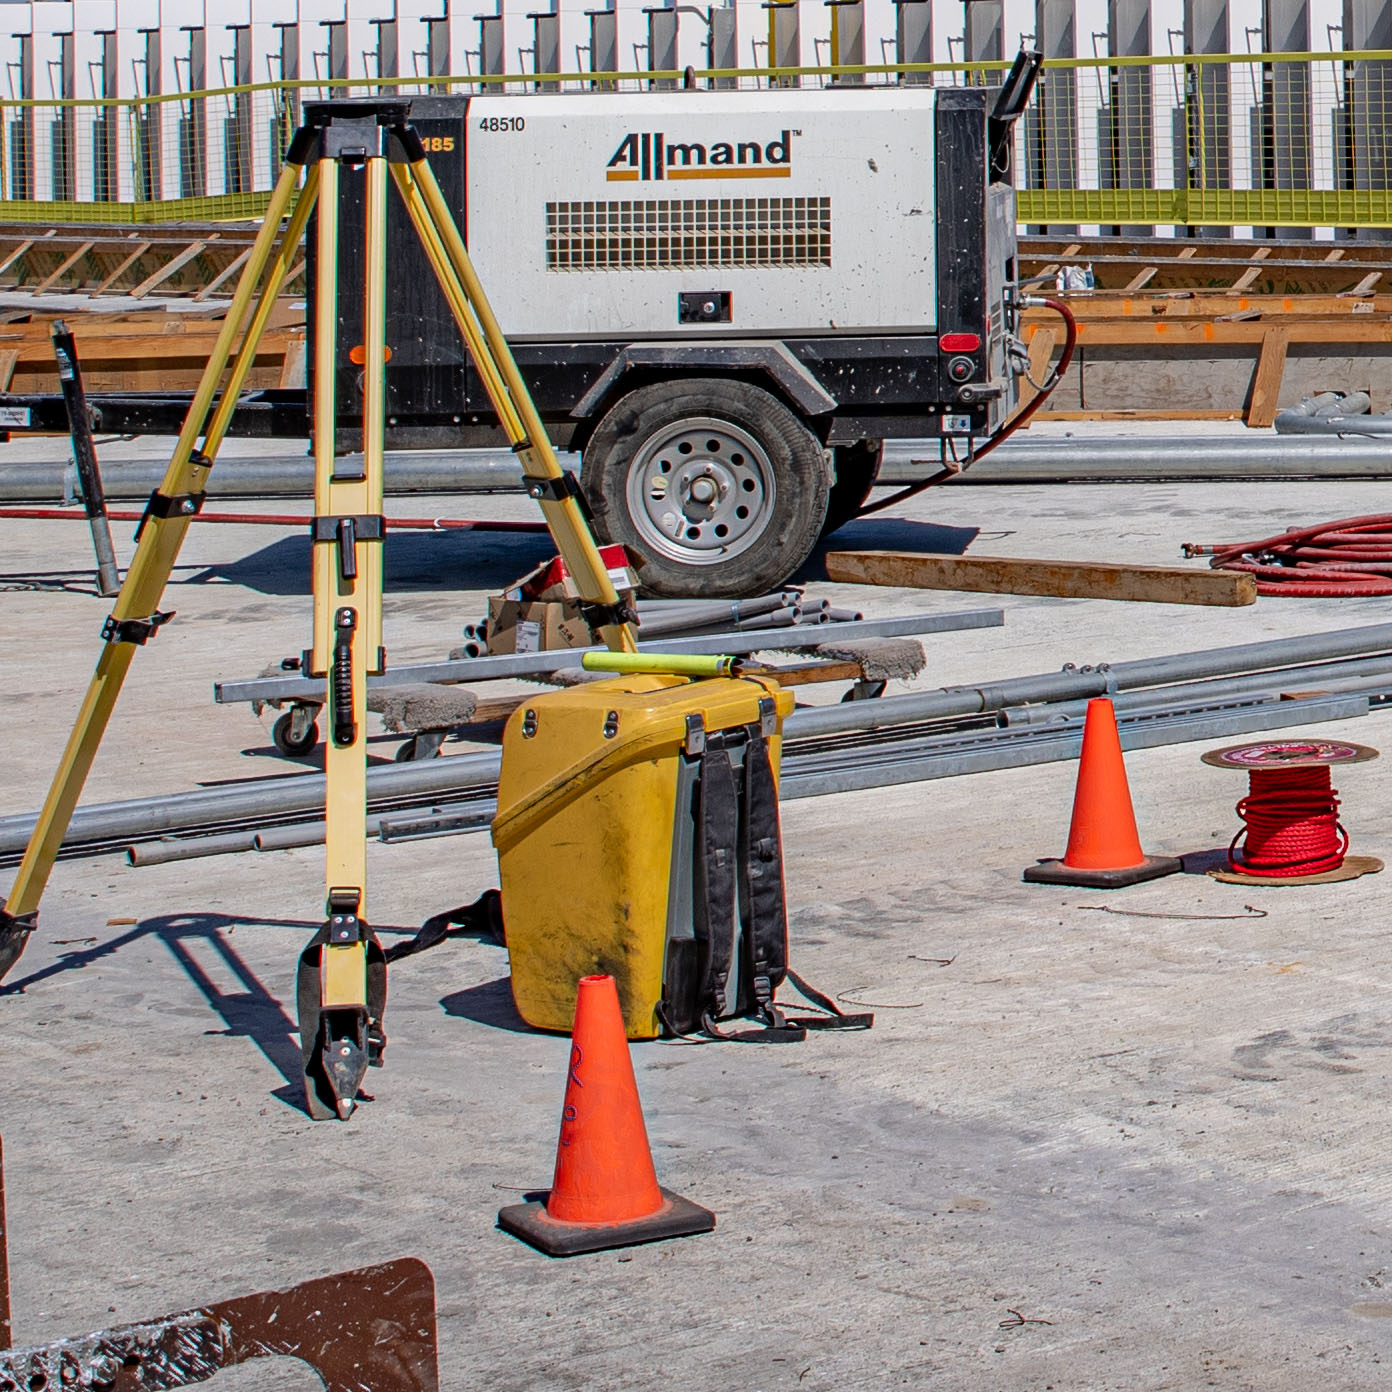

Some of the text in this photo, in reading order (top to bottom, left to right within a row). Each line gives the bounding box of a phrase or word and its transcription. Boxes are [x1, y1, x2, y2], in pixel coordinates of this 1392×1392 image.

[479, 116, 526, 132] 48510
[422, 137, 455, 152] 185
[606, 129, 792, 181] Allmand
